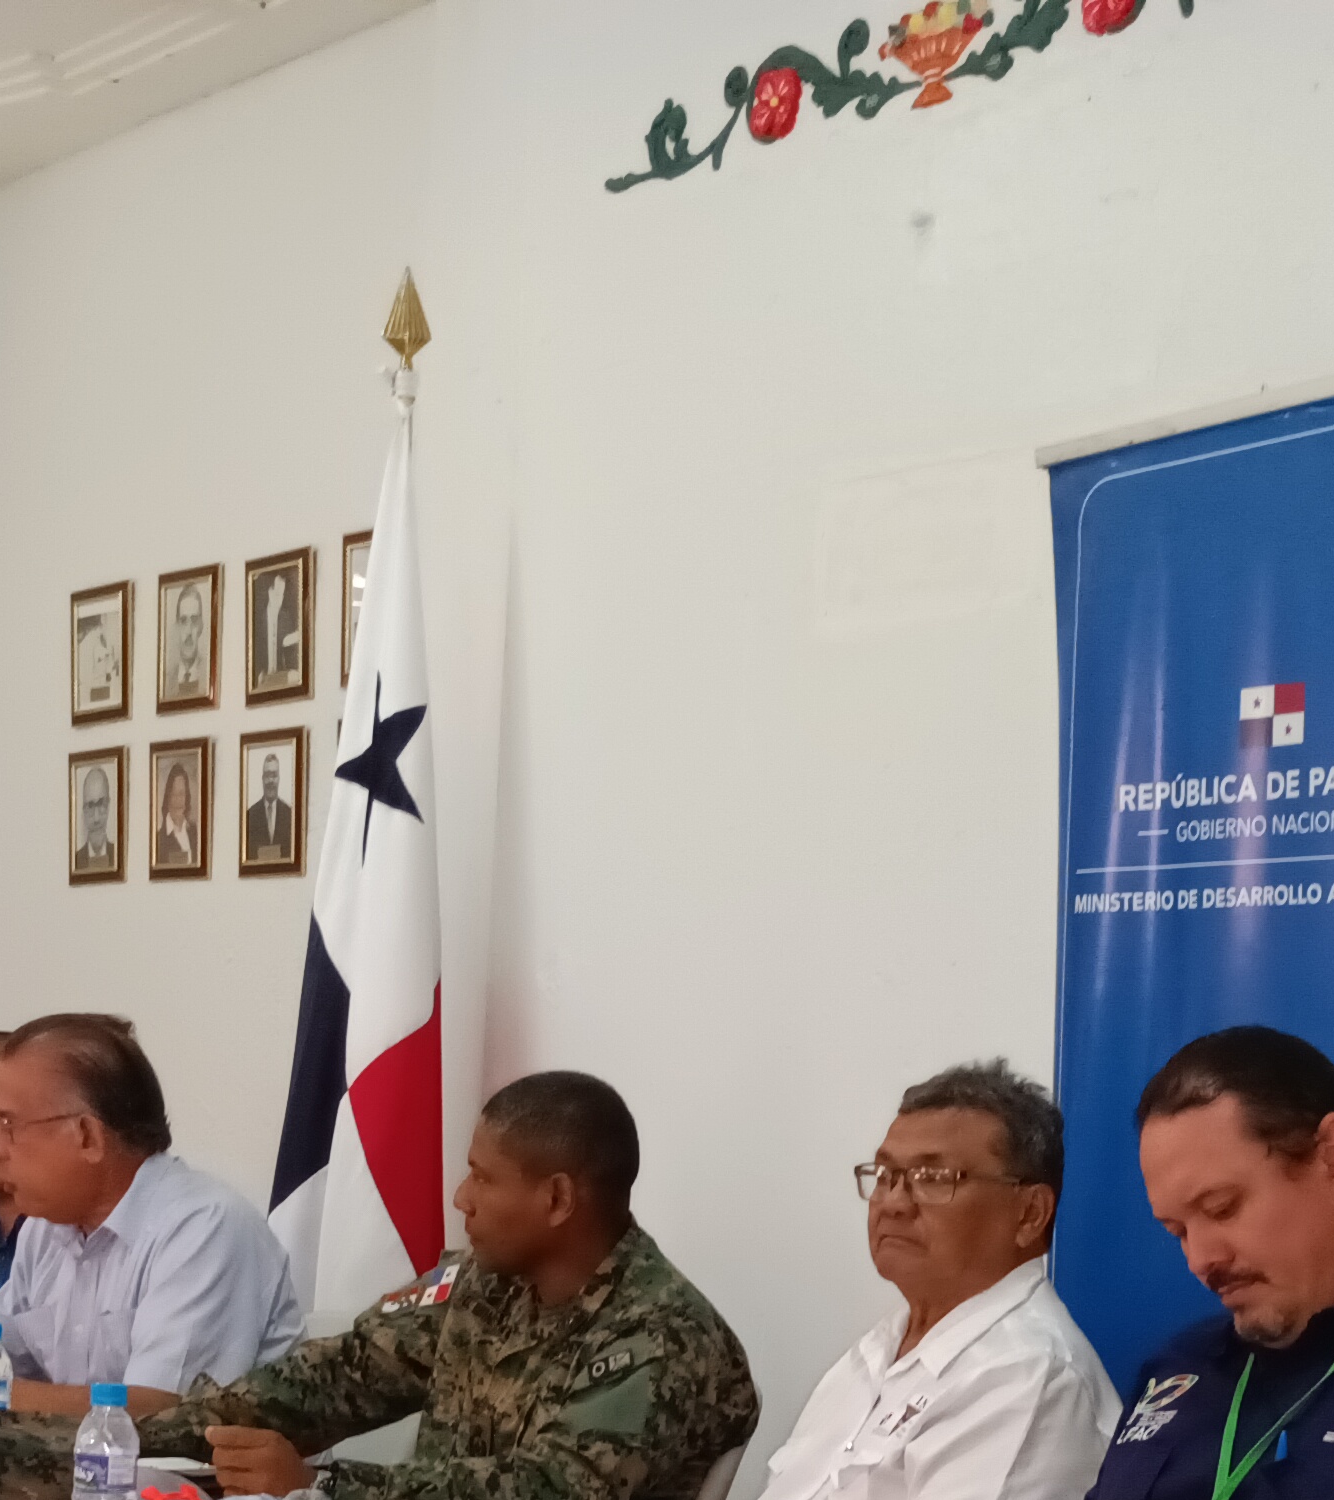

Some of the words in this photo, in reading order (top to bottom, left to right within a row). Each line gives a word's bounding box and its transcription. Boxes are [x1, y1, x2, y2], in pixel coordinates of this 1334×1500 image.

[1119, 772, 1258, 814] REPÚBLICA
[1266, 768, 1301, 801] DE
[1175, 813, 1267, 843] GOBIERNO
[1074, 890, 1175, 914] MINISTERIO
[1177, 888, 1198, 909] DE
[1202, 881, 1323, 909] DESARROLLO
